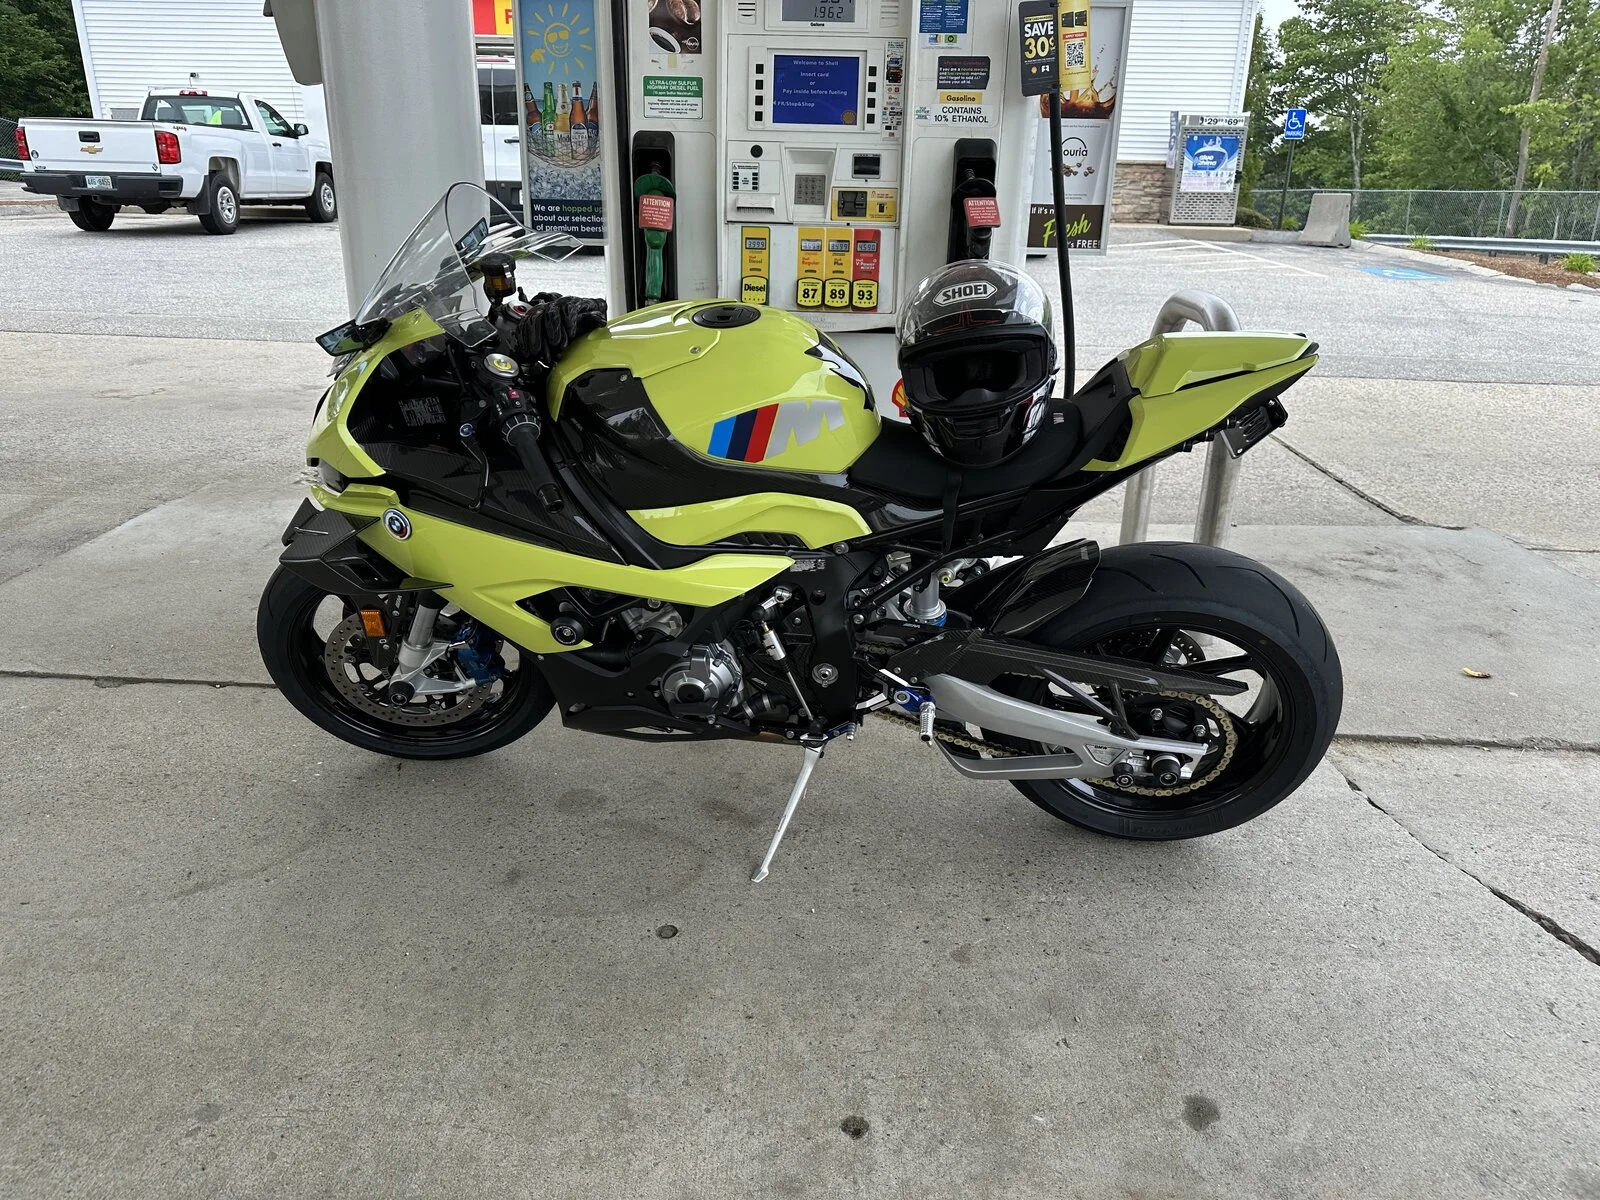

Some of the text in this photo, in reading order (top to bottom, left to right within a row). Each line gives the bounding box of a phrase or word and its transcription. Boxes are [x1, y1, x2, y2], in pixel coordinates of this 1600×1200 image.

[814, 6, 844, 19] 1.962
[1024, 22, 1054, 37] SAVE
[946, 94, 976, 102] Gasoline
[941, 106, 982, 115] CONTAINS
[934, 114, 989, 123] 10% ETHANOL
[1062, 147, 1088, 157] ouria
[643, 198, 671, 207] ATTENTION
[562, 205, 592, 213] hopped
[1037, 206, 1048, 215] it's
[545, 224, 579, 232] premium
[1043, 213, 1092, 247] Fesh
[744, 283, 766, 292] Diesel
[802, 288, 818, 299] 87
[829, 288, 846, 300] 89
[857, 289, 873, 301] 93
[942, 284, 987, 302] SHOEI
